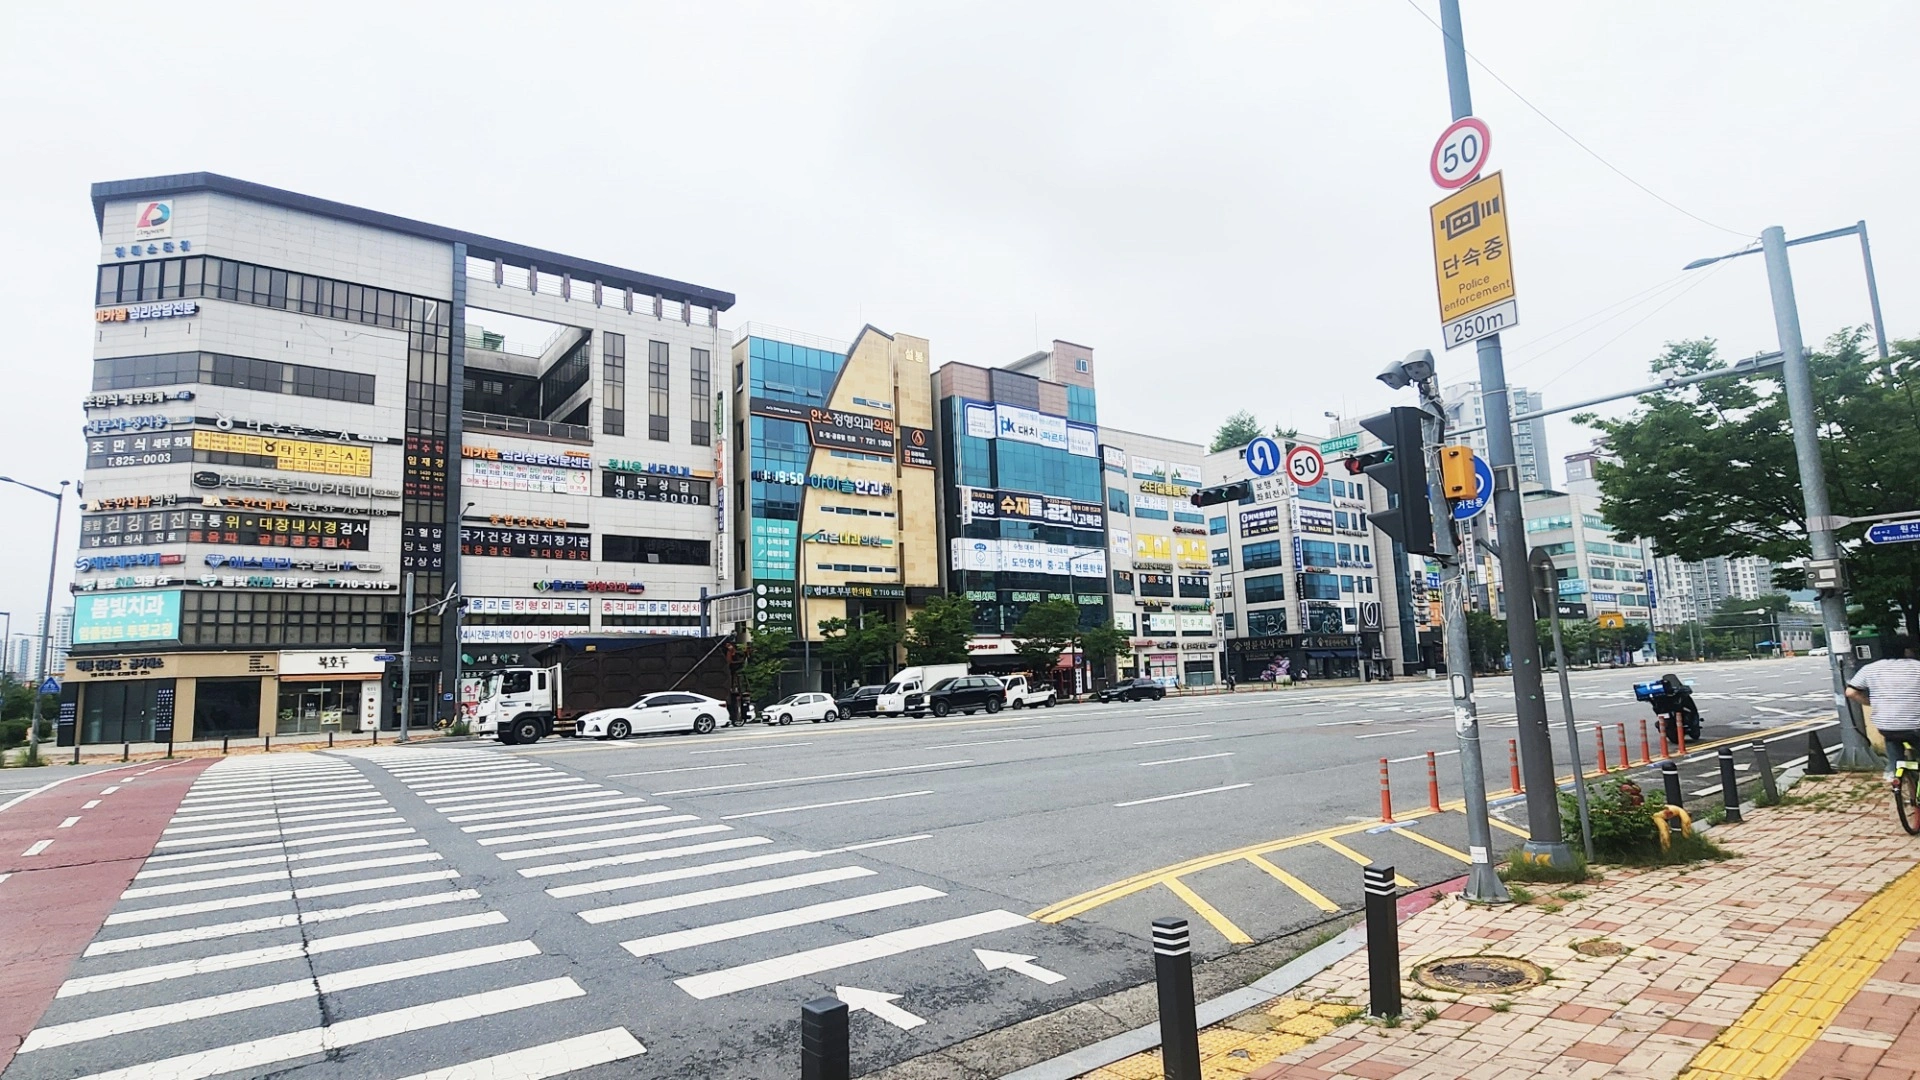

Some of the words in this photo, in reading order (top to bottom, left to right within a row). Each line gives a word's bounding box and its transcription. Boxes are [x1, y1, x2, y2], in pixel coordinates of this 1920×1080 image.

[1443, 134, 1477, 173] 50
[1443, 236, 1504, 279] 단속중
[1459, 275, 1490, 294] Police
[1444, 279, 1511, 312] enforcement
[94, 308, 127, 323] 미카엘
[1454, 313, 1504, 343] 250m
[87, 417, 125, 434] 세무사
[811, 409, 894, 434] 안스정형외과의원
[1018, 425, 1038, 439] 대치
[107, 453, 171, 467] T.825-0003
[461, 445, 499, 460] 미카엘
[1293, 456, 1317, 477] 50
[614, 475, 690, 493] 세무상담
[811, 473, 883, 496] 아이솔안과
[1256, 480, 1272, 491] 보행
[1275, 478, 1284, 487] 및
[615, 489, 699, 505] 365-3000
[1256, 488, 1289, 501] 좌회전시
[226, 496, 318, 513] 도안내과의원
[1001, 495, 1043, 517] 수재들
[1455, 498, 1484, 510] 거전용
[105, 512, 185, 534] 건강검진
[404, 527, 442, 539] 고혈압
[459, 529, 589, 547] 국가건강검진지정기관
[817, 532, 882, 548] 고은내과의원
[404, 542, 442, 553] 당뇨병
[404, 556, 442, 568] 갑상선
[1012, 557, 1043, 568] 도안영어
[1074, 562, 1104, 574] 전문학원
[221, 574, 298, 589] 봄빛치과의원
[301, 578, 319, 589] 2F
[339, 579, 390, 590] 710-5115
[768, 586, 793, 594] 교통사고
[90, 594, 165, 620] 봄빛치과
